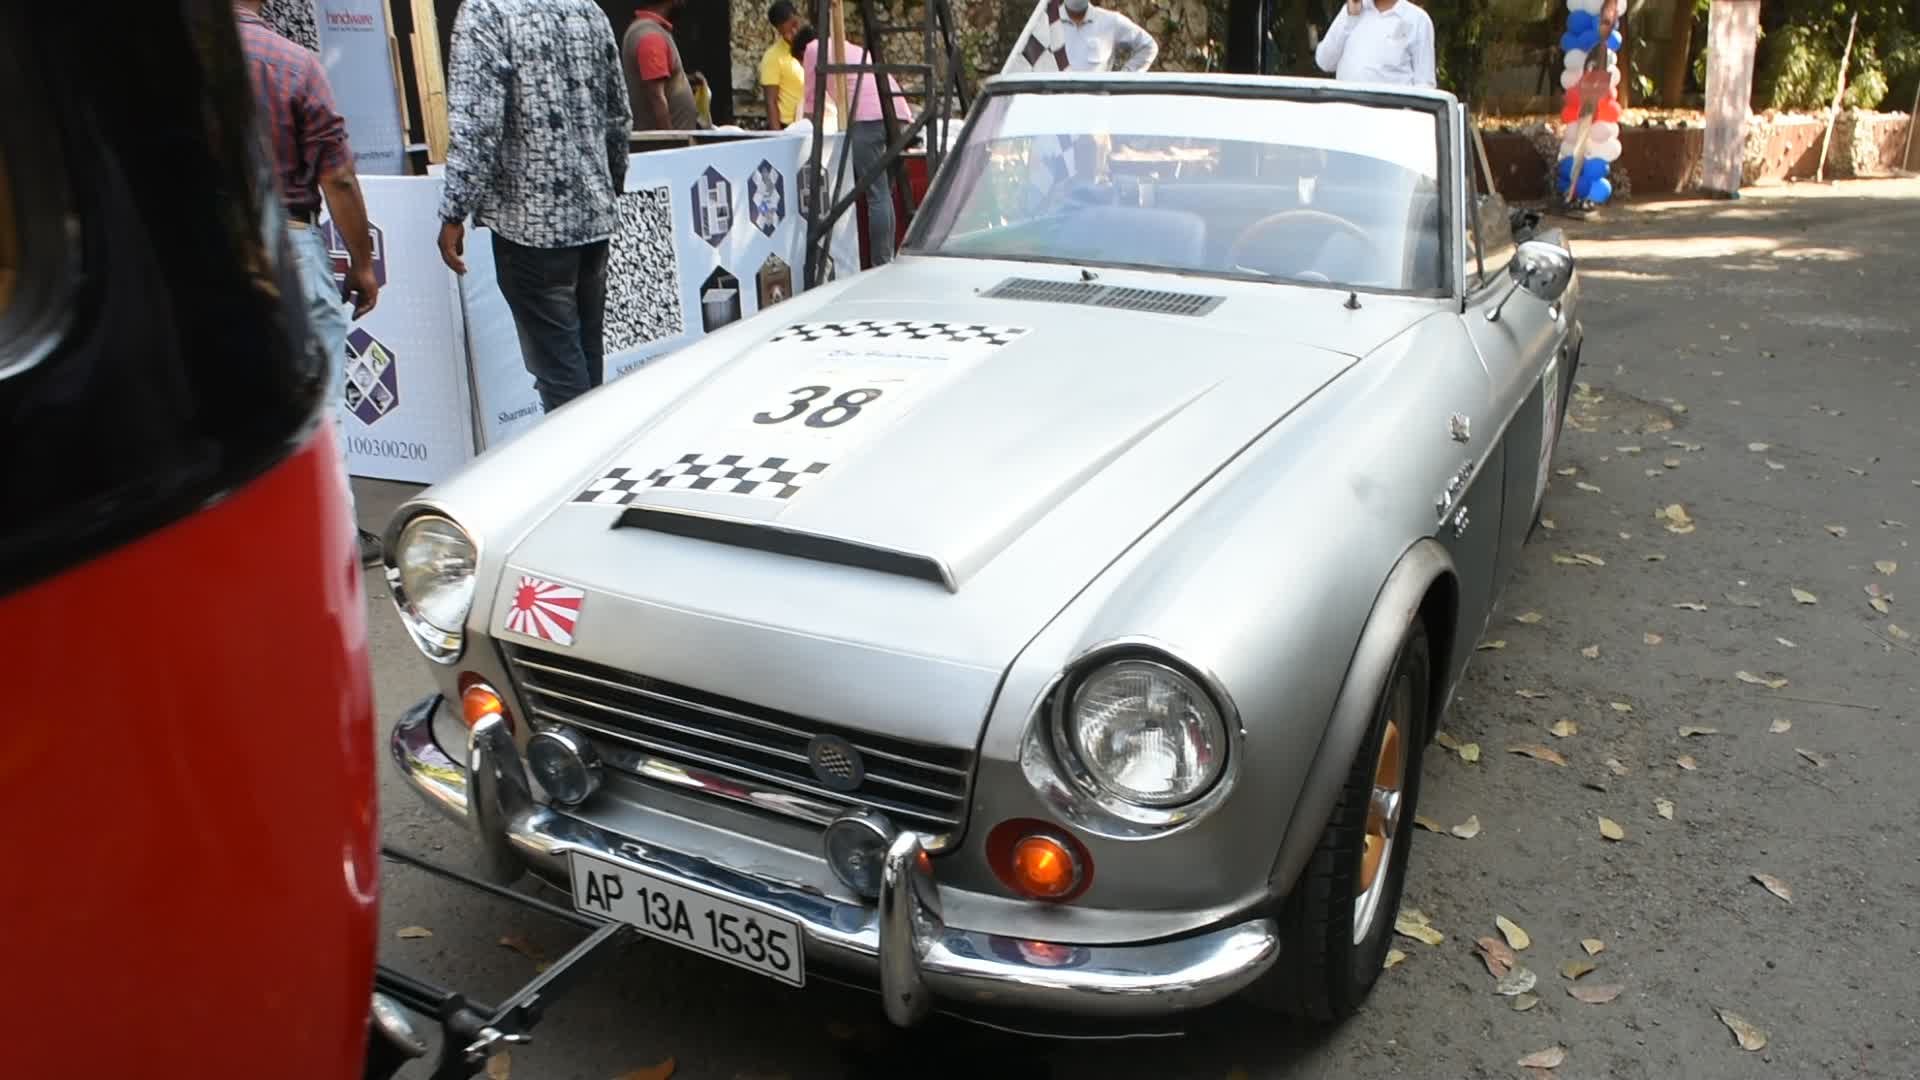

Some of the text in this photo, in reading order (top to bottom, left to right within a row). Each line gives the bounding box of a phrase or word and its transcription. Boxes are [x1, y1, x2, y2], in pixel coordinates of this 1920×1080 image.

[324, 8, 374, 25] hindware
[752, 385, 883, 429] 38
[346, 435, 428, 461] 100300200
[586, 870, 791, 971] AP 13A 1535
